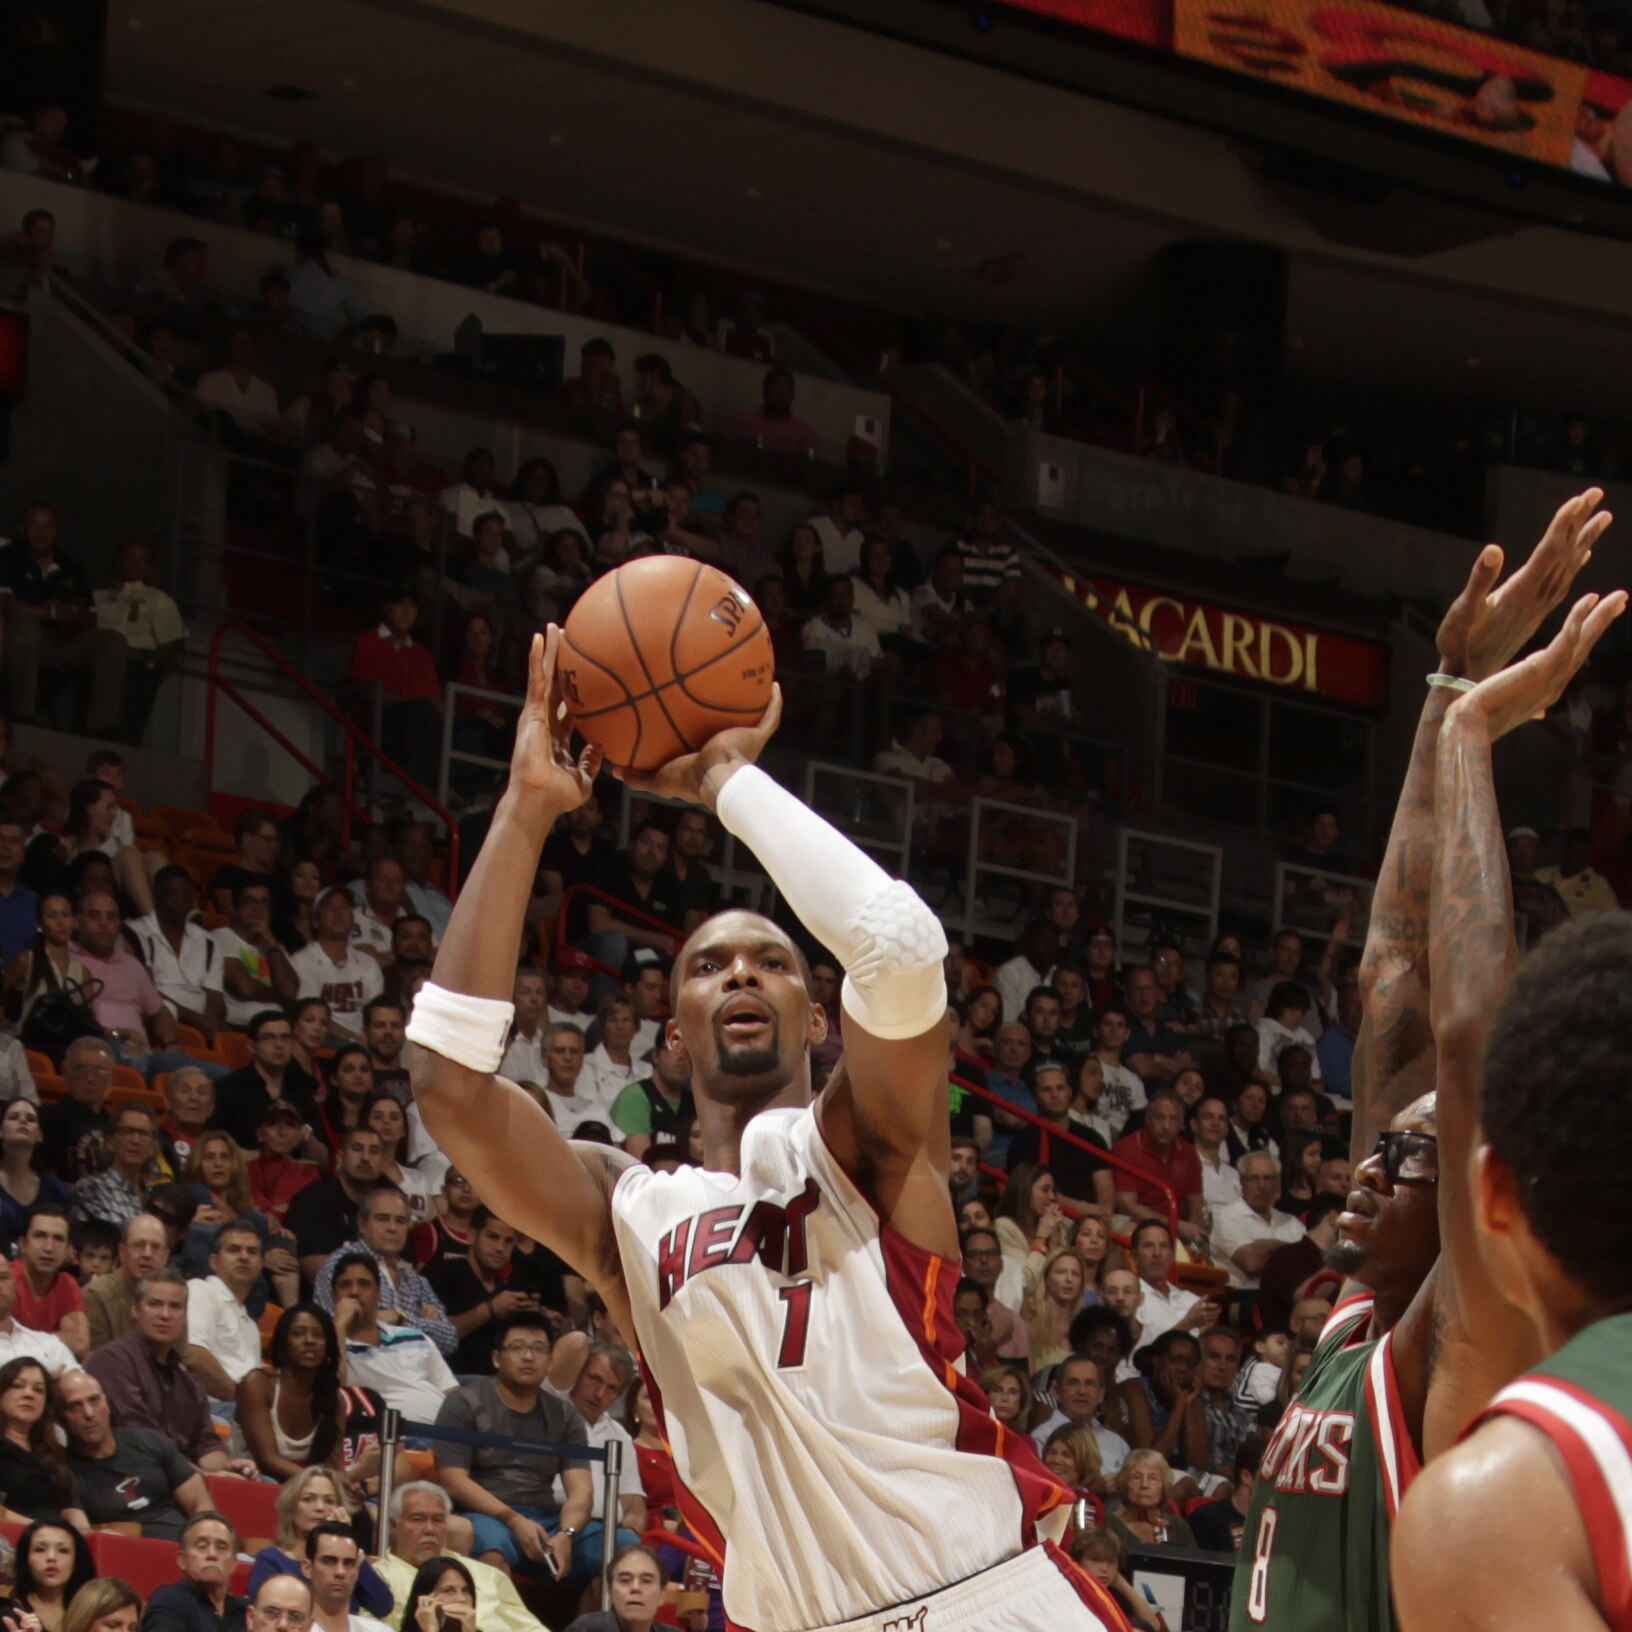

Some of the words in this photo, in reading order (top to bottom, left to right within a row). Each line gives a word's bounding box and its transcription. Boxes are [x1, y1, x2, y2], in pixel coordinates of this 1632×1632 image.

[658, 1176, 822, 1313] HEAT
[778, 1280, 813, 1369] 1
[1247, 1506, 1280, 1625] 8
